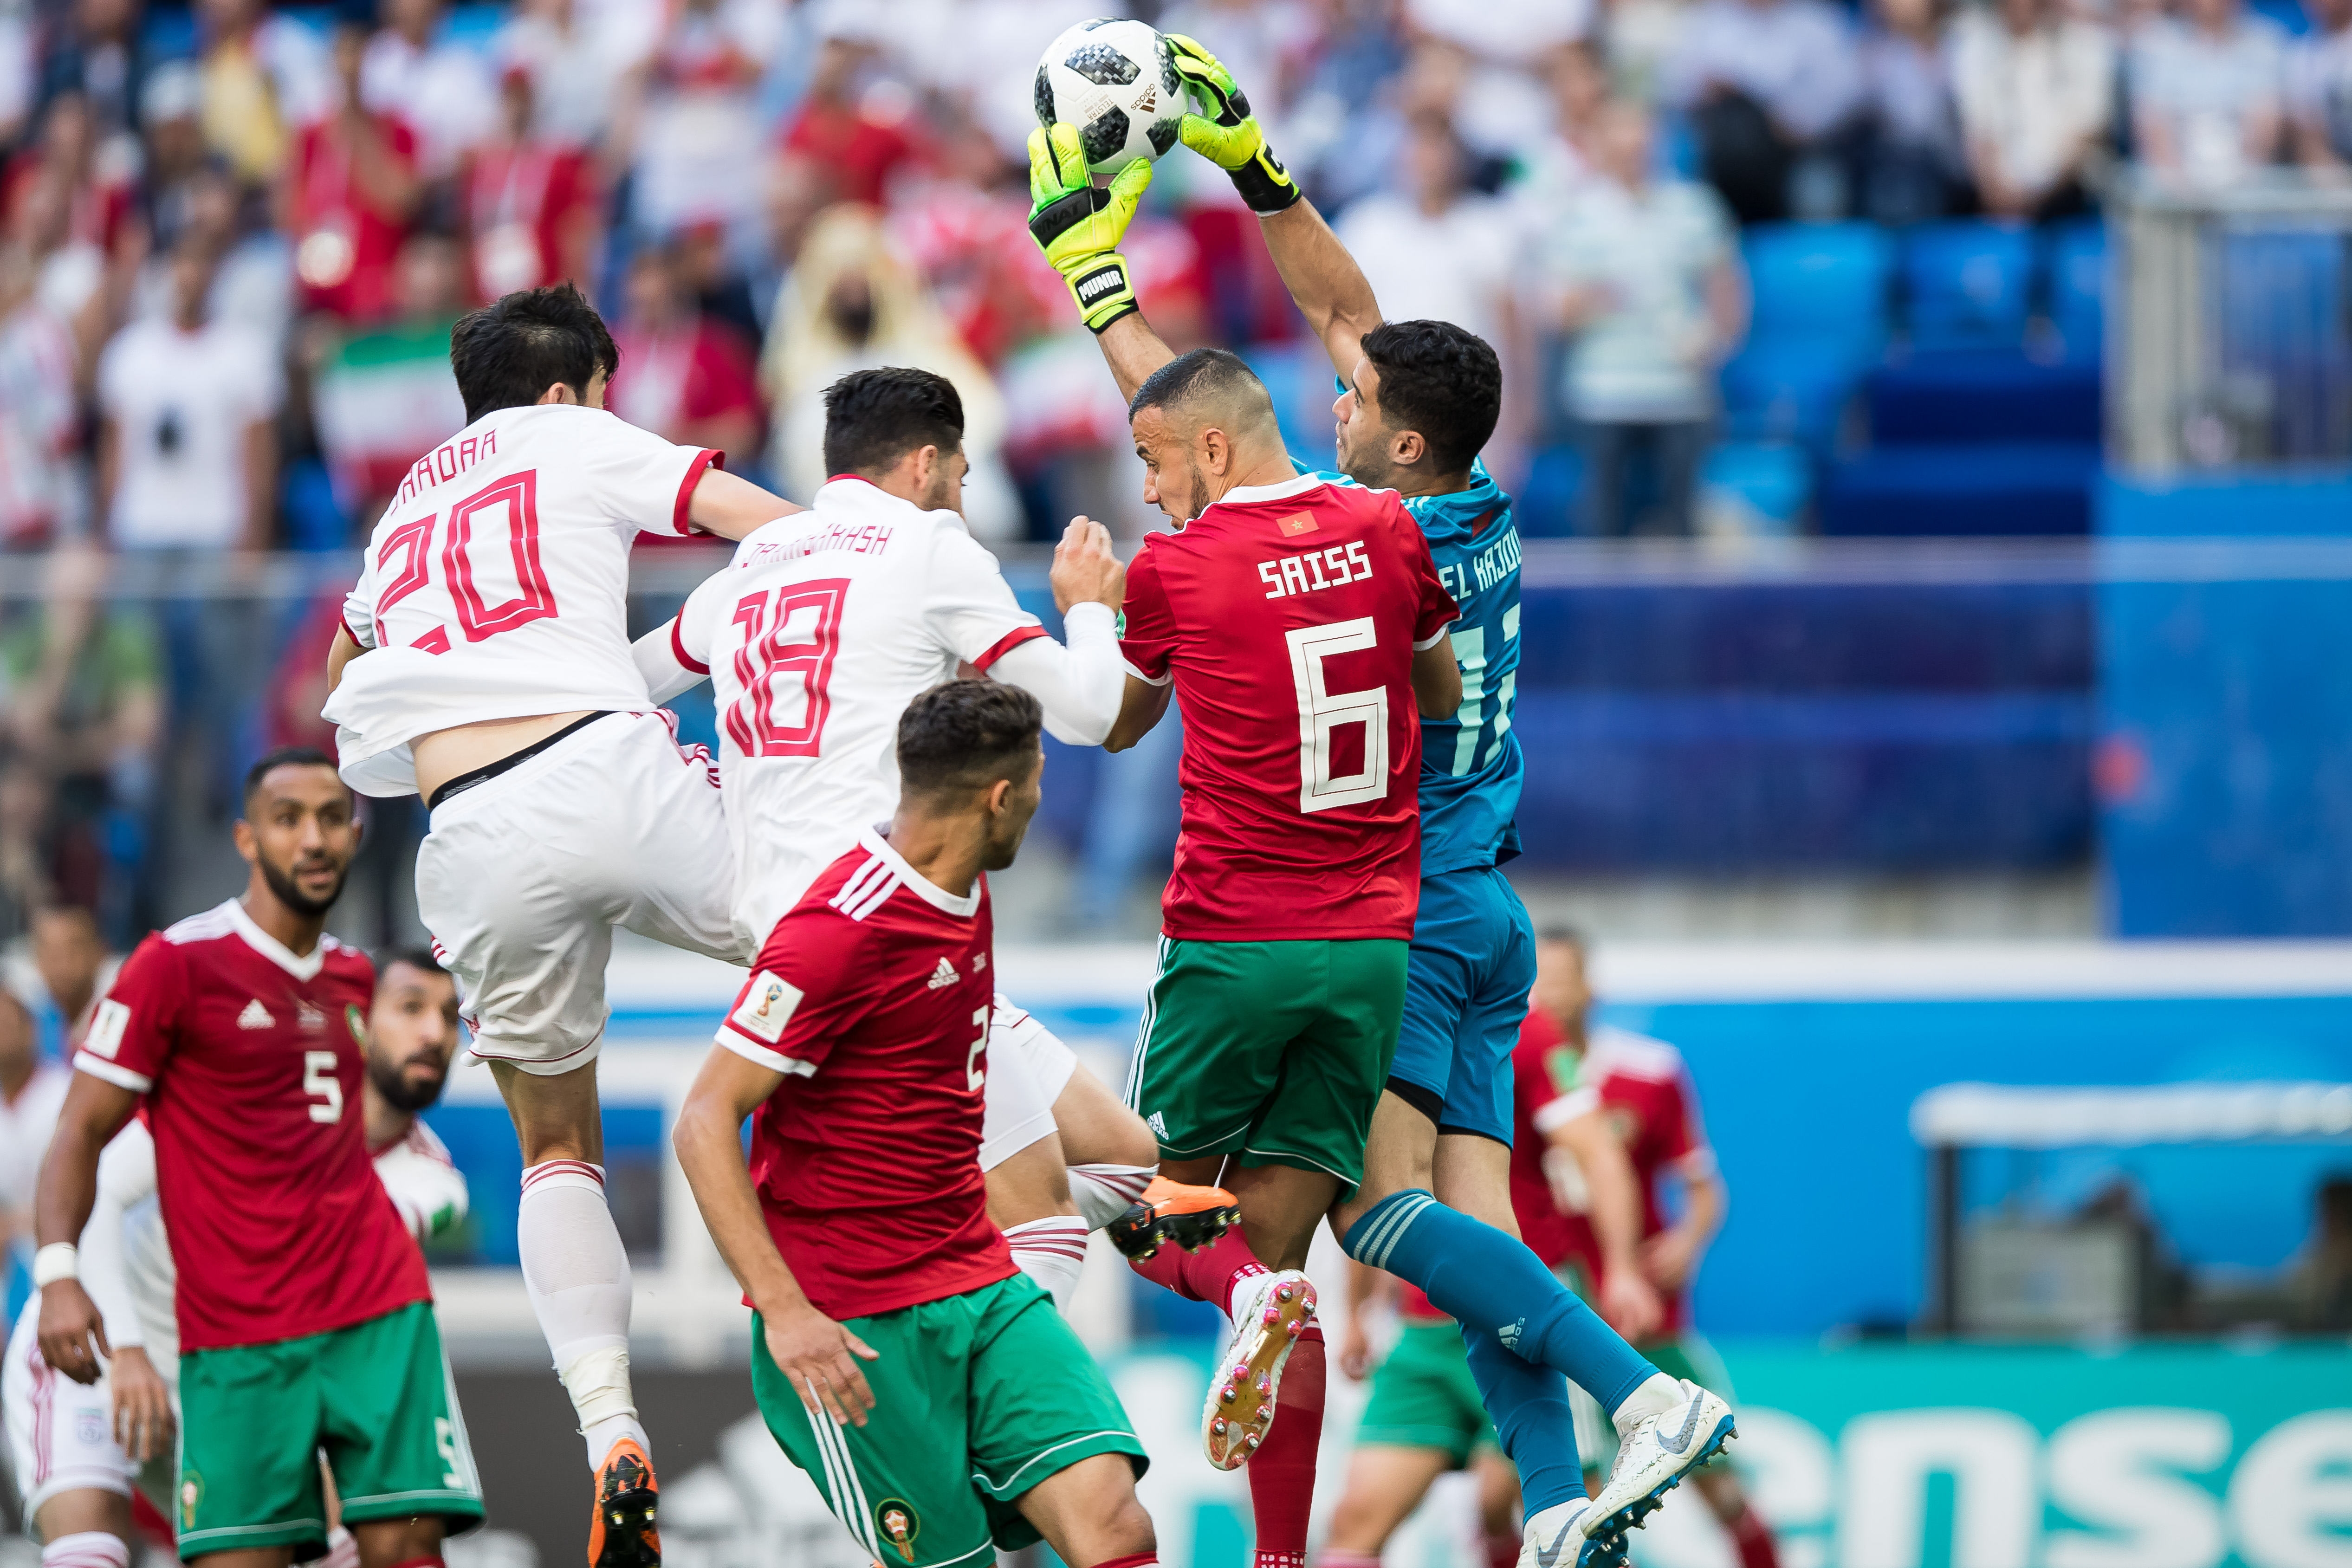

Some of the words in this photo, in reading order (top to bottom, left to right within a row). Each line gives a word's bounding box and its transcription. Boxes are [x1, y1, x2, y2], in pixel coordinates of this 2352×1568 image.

[1087, 98, 1114, 120] TELSTAR
[1131, 84, 1155, 110] adidas
[1078, 270, 1123, 301] MUNIR
[391, 428, 496, 516] ARDAR
[376, 468, 559, 655] 20
[1257, 540, 1373, 599] SAISS
[1438, 563, 1471, 602] EL
[726, 578, 853, 758] 18
[1284, 616, 1388, 814] 6
[967, 1004, 988, 1092] 2
[304, 1051, 343, 1124] 5
[1147, 1117, 1169, 1140] adidas
